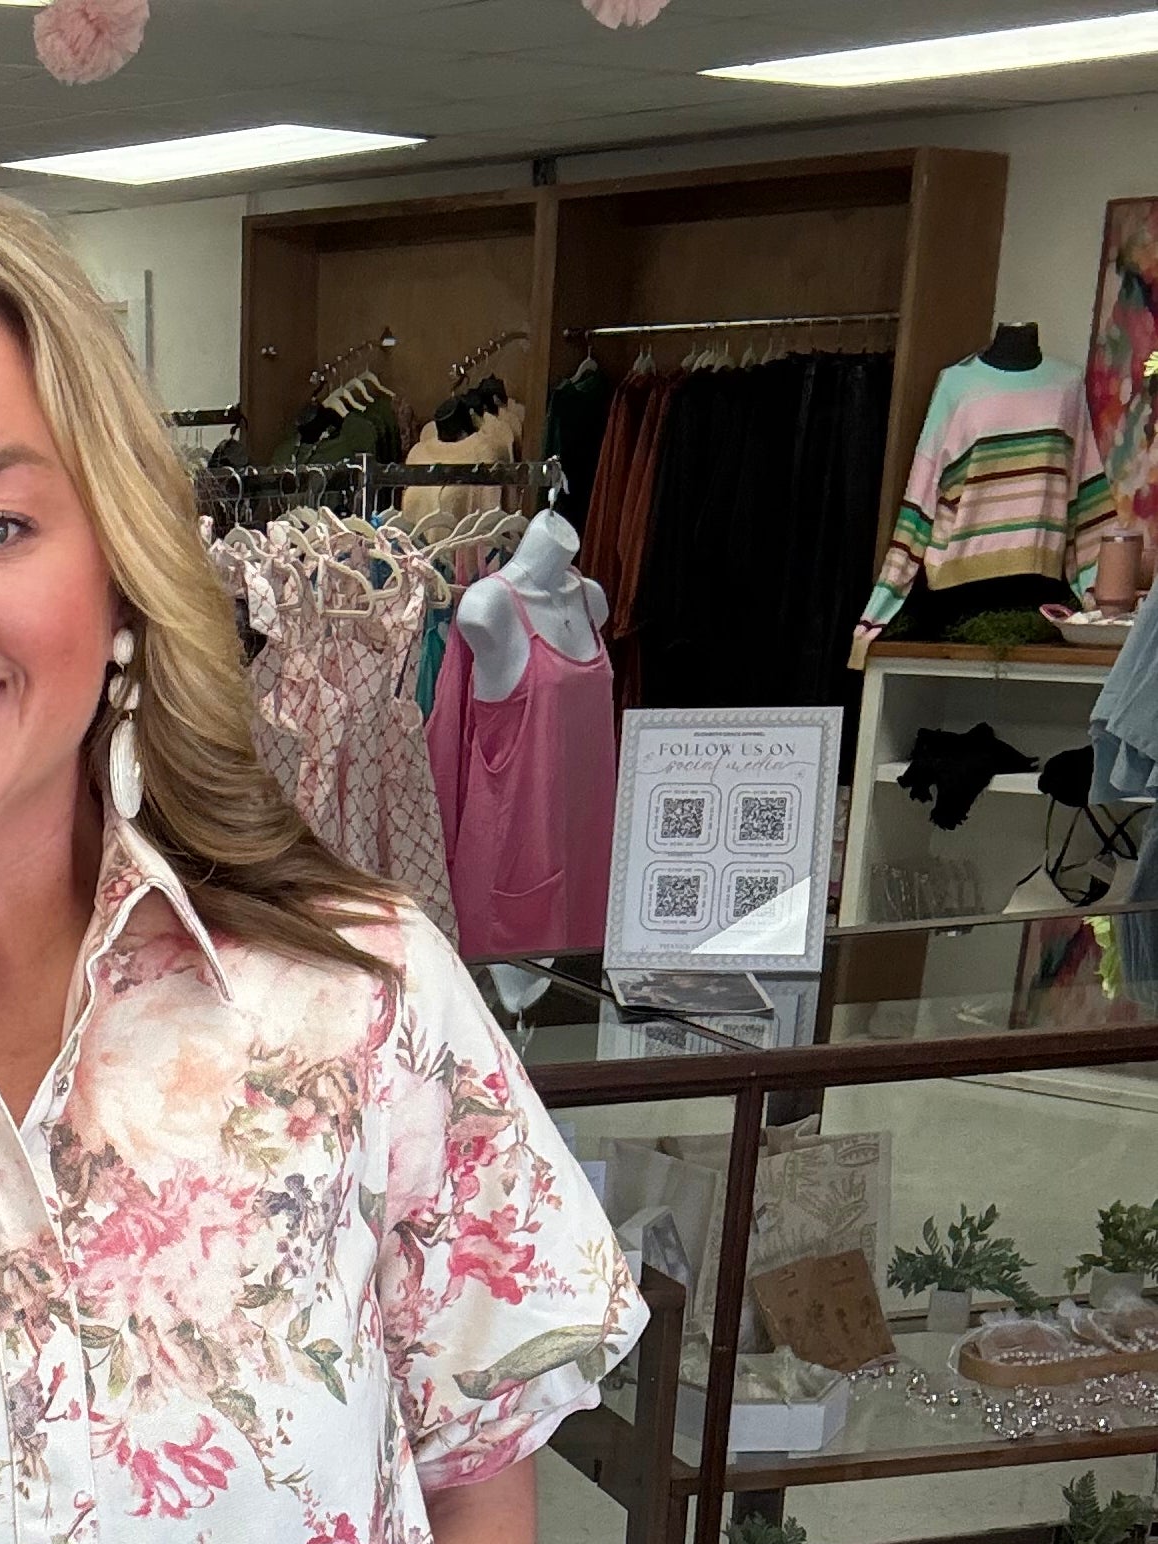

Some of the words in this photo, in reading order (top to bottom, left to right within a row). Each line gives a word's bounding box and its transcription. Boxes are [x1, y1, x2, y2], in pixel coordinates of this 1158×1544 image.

[659, 742, 735, 757] FOLLOW
[741, 742, 764, 757] US
[769, 742, 796, 757] ON
